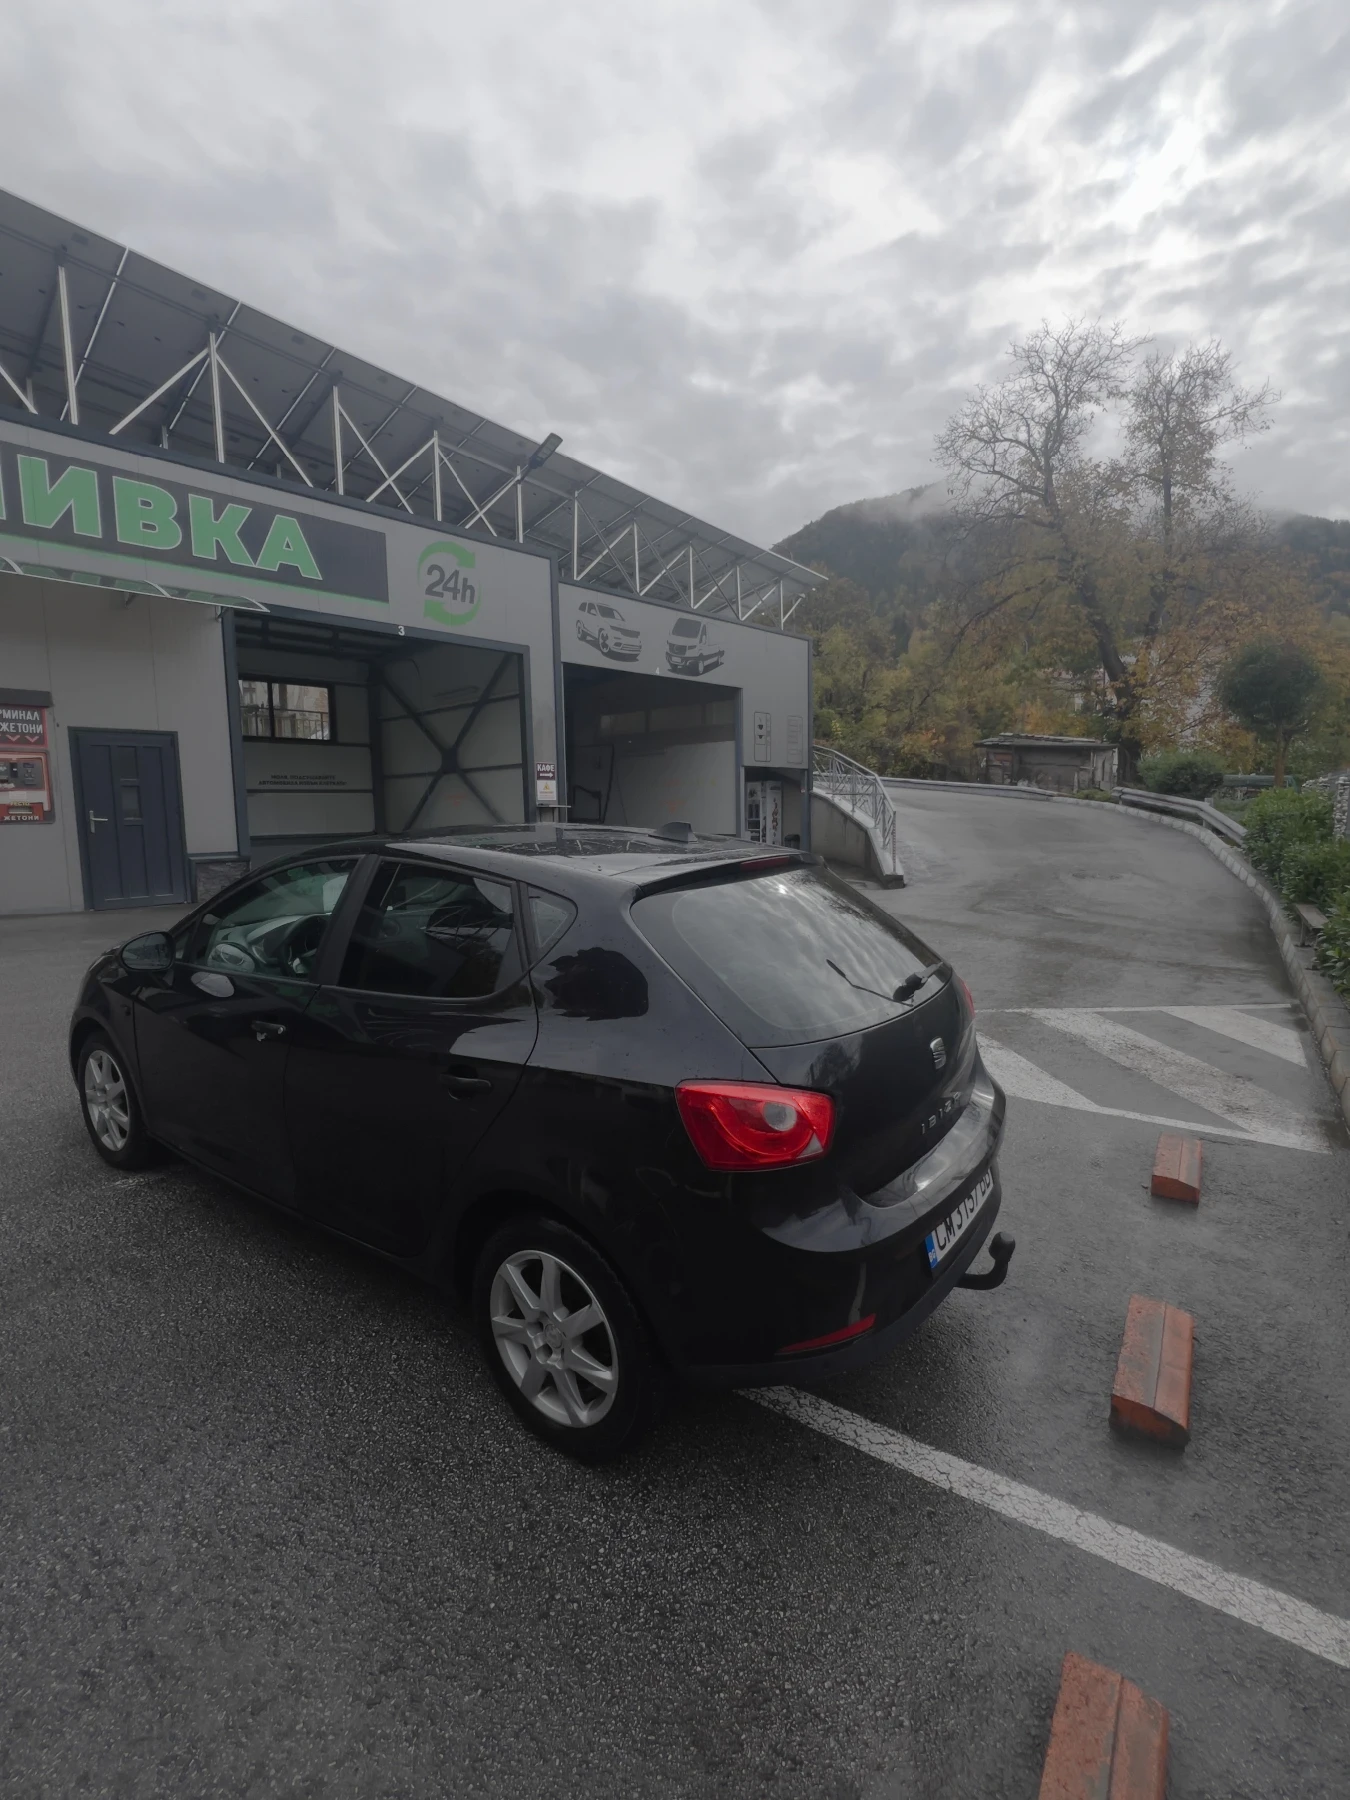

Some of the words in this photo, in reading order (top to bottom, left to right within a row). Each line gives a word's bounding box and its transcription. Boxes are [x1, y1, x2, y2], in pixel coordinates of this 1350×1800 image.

[0, 454, 323, 580] ИВКА
[425, 564, 476, 605] 24h
[398, 625, 406, 636] 3
[0, 722, 43, 734] ЖЕТОНИ
[537, 763, 555, 772] КАФЕ
